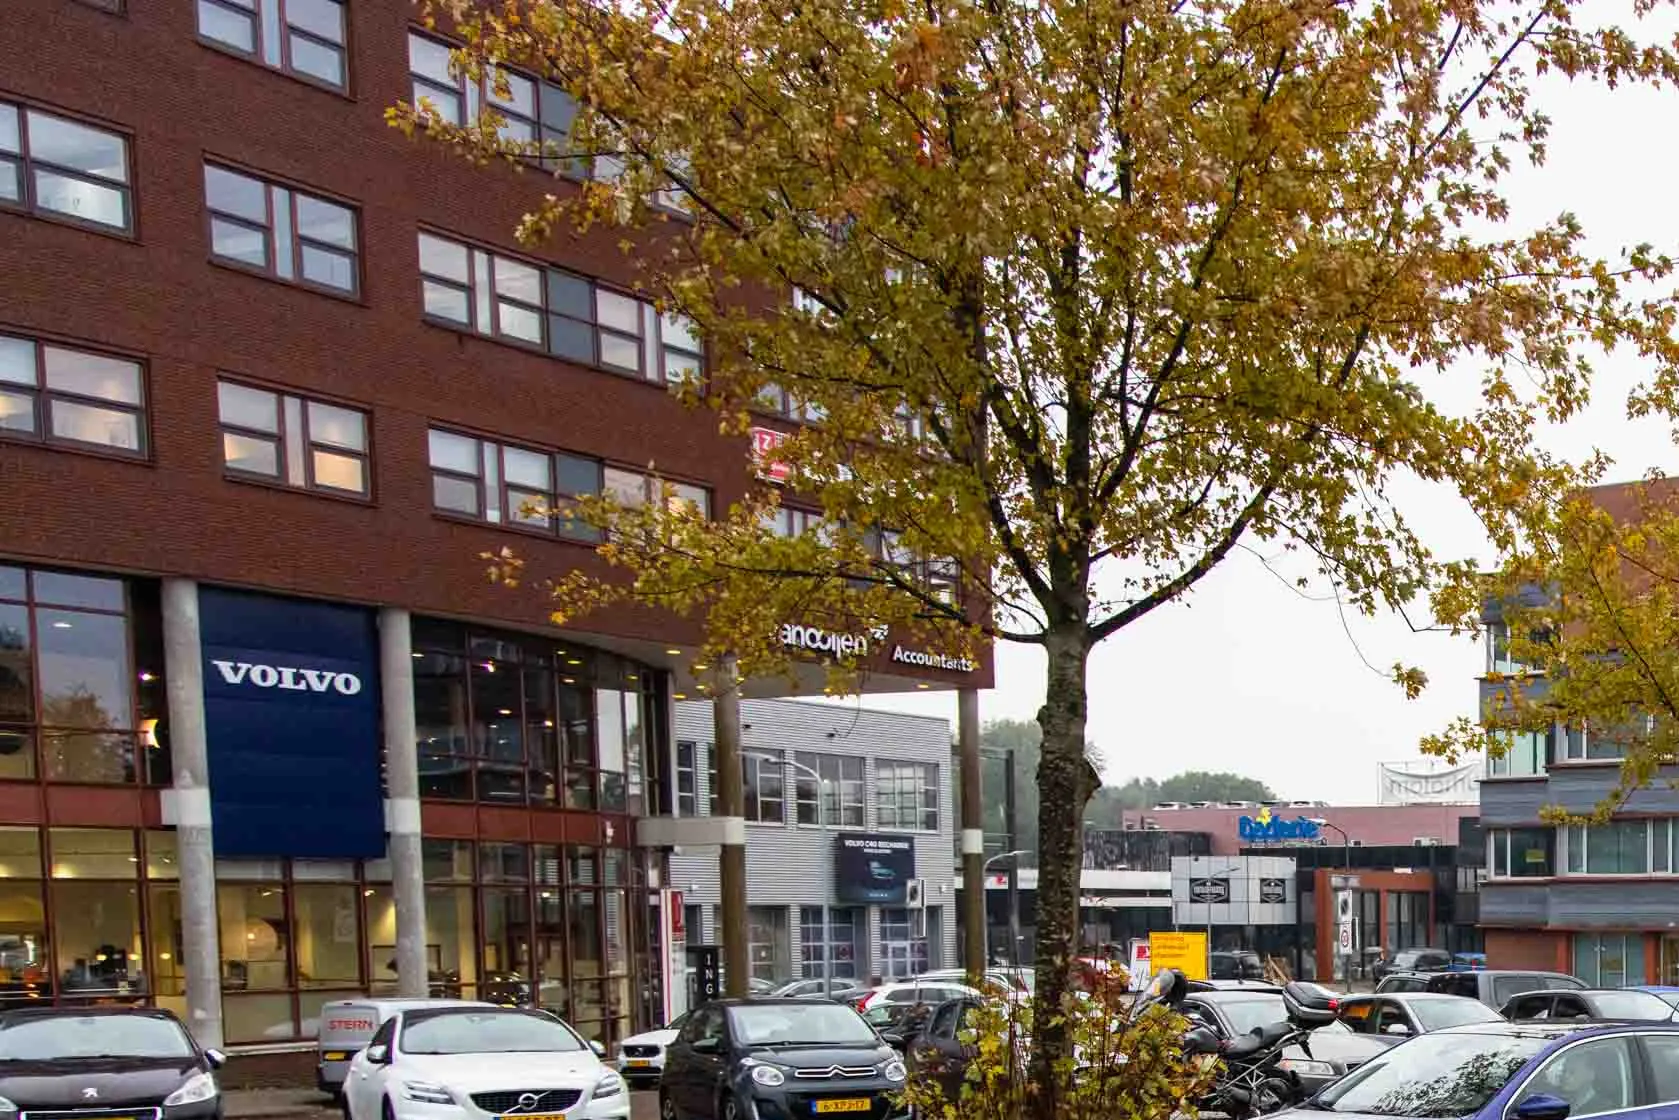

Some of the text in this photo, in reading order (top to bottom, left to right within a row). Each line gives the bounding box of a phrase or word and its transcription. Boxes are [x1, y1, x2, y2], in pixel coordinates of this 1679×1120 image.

[893, 645, 974, 672] Accountants
[210, 660, 362, 695] VOLVO
[328, 1020, 375, 1031] STERN
